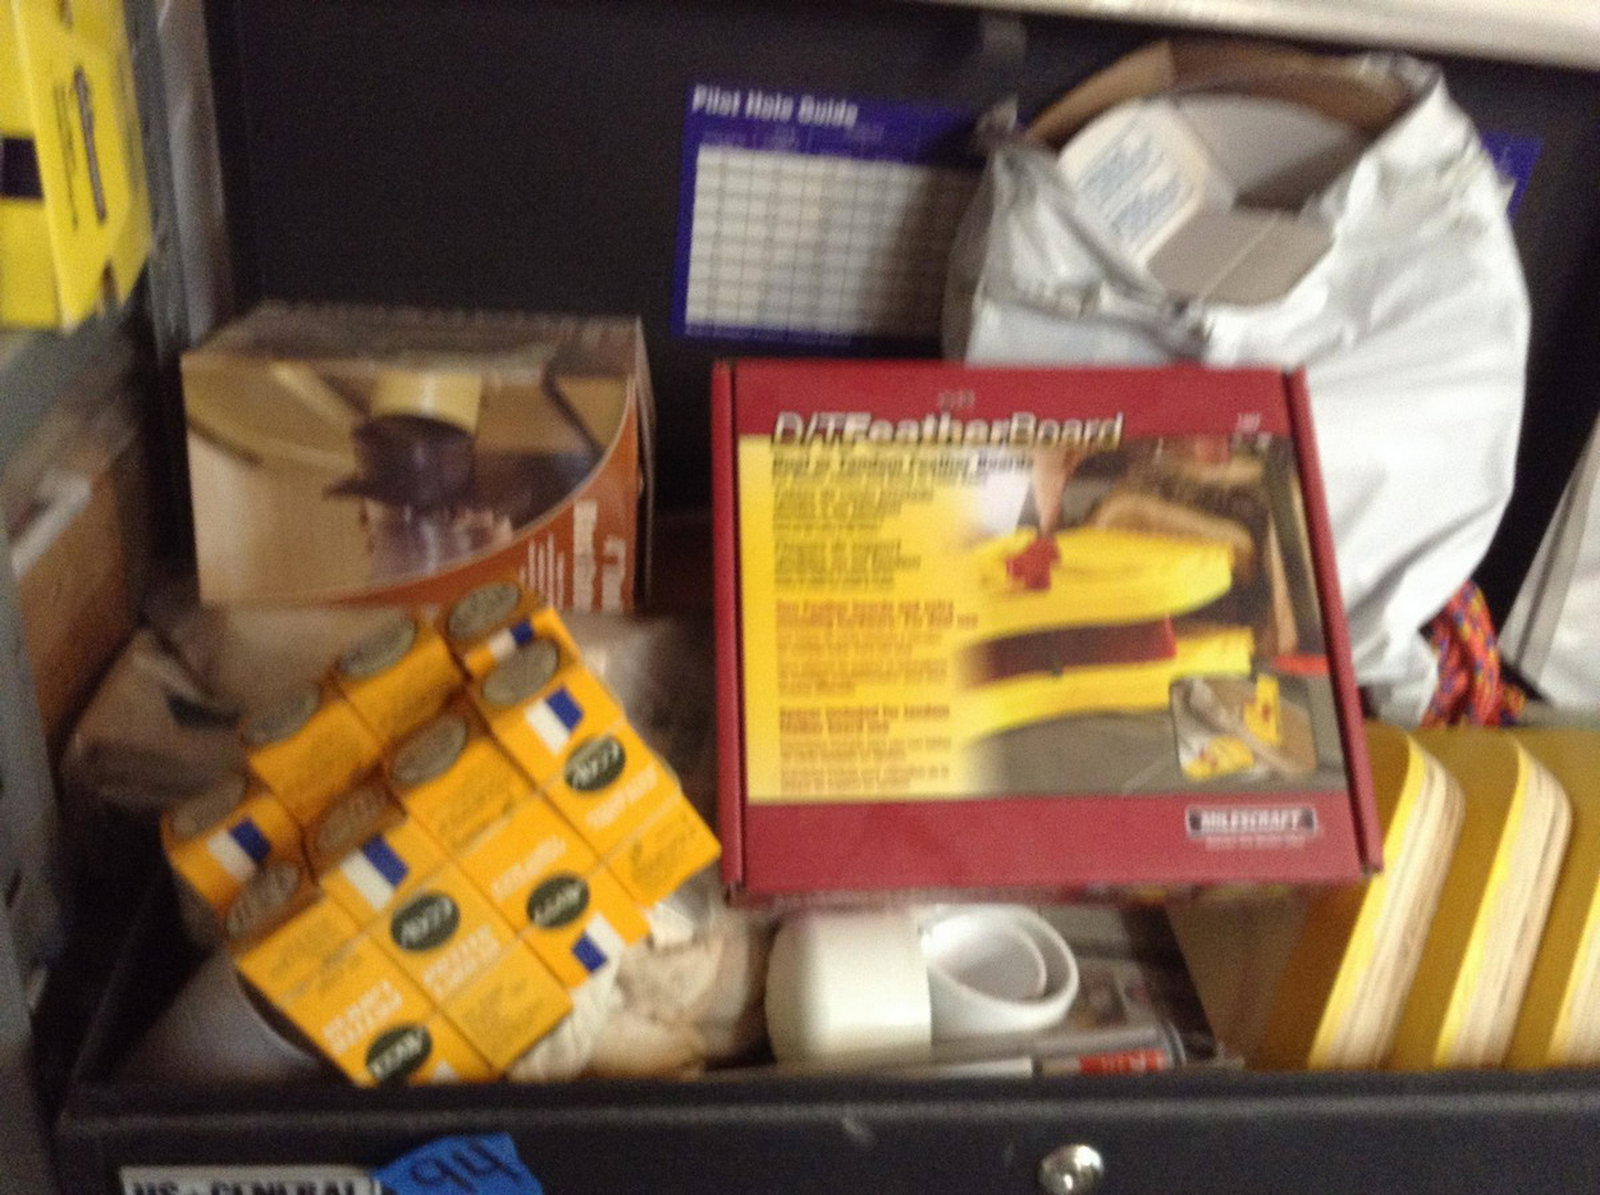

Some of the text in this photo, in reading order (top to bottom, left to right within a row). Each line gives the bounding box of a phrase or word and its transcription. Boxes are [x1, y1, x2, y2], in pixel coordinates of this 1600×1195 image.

[692, 84, 859, 130] Pilot Hole Guide
